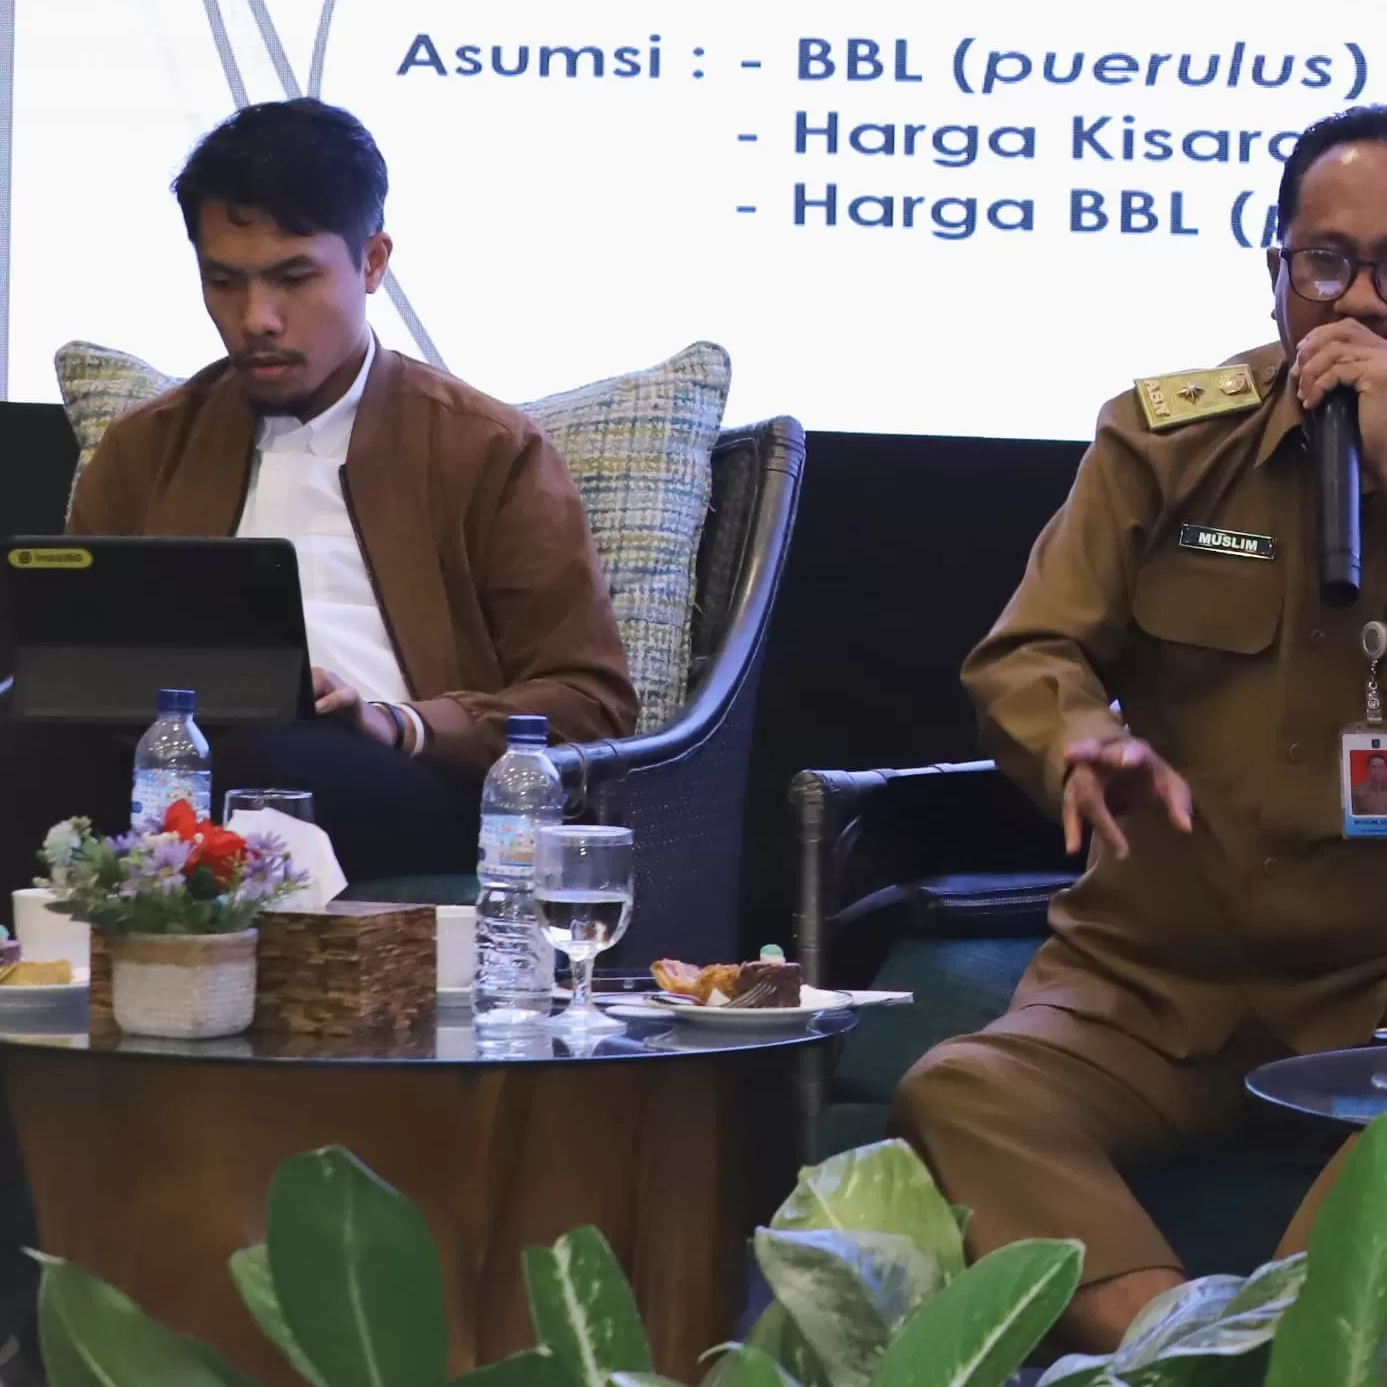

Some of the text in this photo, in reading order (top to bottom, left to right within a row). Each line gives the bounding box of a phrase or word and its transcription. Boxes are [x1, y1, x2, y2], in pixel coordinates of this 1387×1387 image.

[397, 34, 661, 78] Asumsi
[798, 38, 922, 82] BBL
[954, 38, 1367, 100] (puerulus)
[795, 111, 1035, 167] Harga
[794, 183, 1034, 240] Harga
[1070, 189, 1198, 235] BBL
[1143, 379, 1170, 417] ASN
[1198, 531, 1258, 552] MUSLIM
